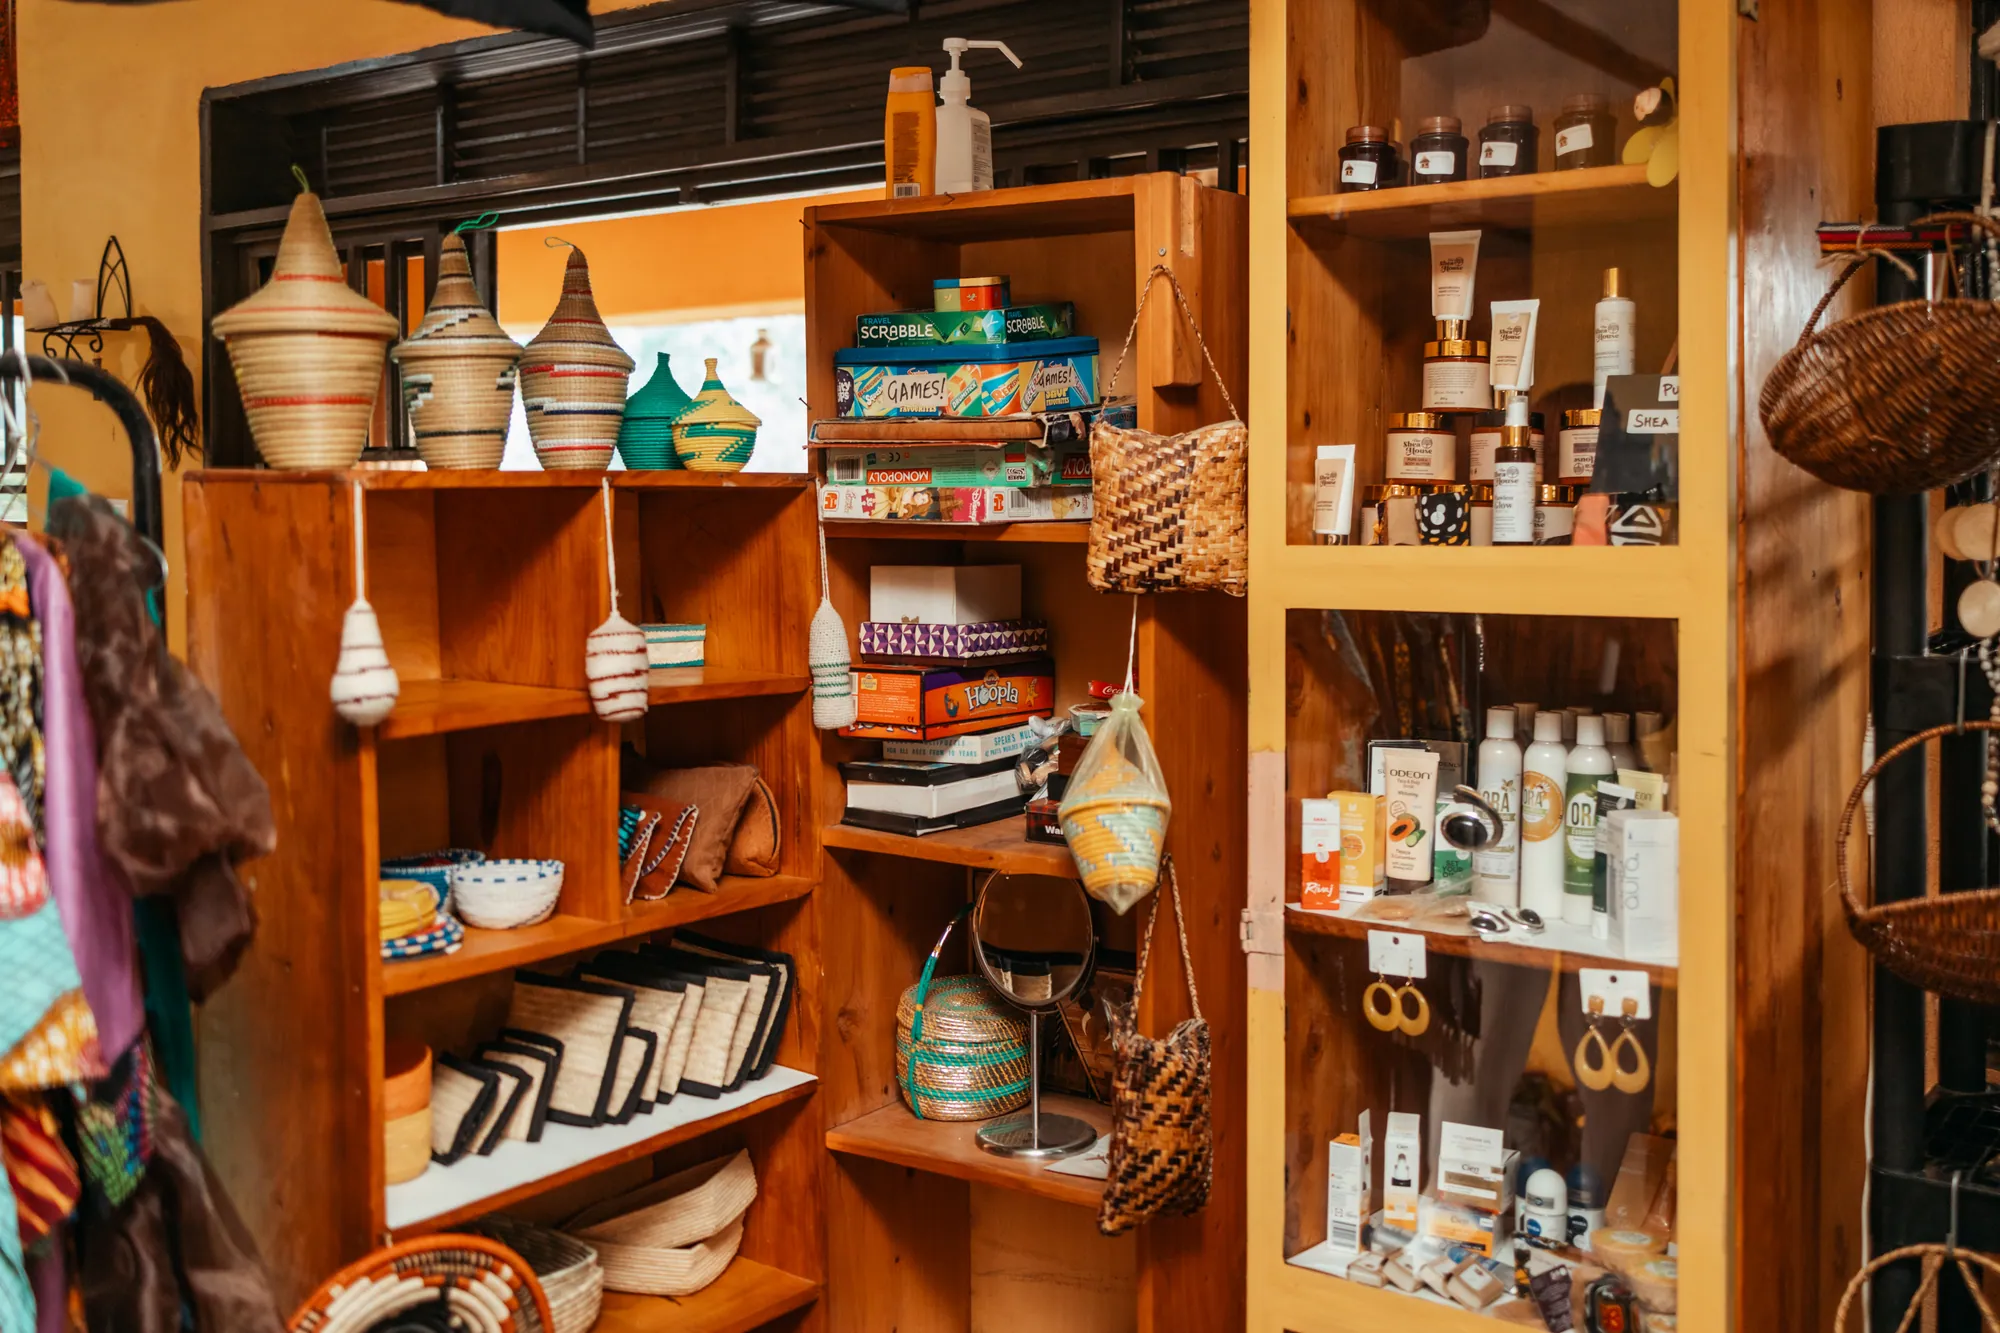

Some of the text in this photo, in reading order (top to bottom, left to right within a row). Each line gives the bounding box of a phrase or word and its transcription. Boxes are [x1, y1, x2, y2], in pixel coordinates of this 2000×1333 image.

[864, 317, 891, 325] TRAVEL
[1006, 316, 1046, 334] SCRABBLE
[861, 324, 934, 341] SCRABBLE
[1037, 367, 1072, 388] GAMES!
[888, 377, 946, 403] GAMES!
[952, 381, 978, 408] DRUMSTICK
[1633, 414, 1669, 428] SHEA
[1406, 447, 1433, 456] House
[868, 470, 930, 483] MONOPOLY
[994, 732, 1016, 746] SPEAR'S
[1390, 769, 1430, 779] ODEON
